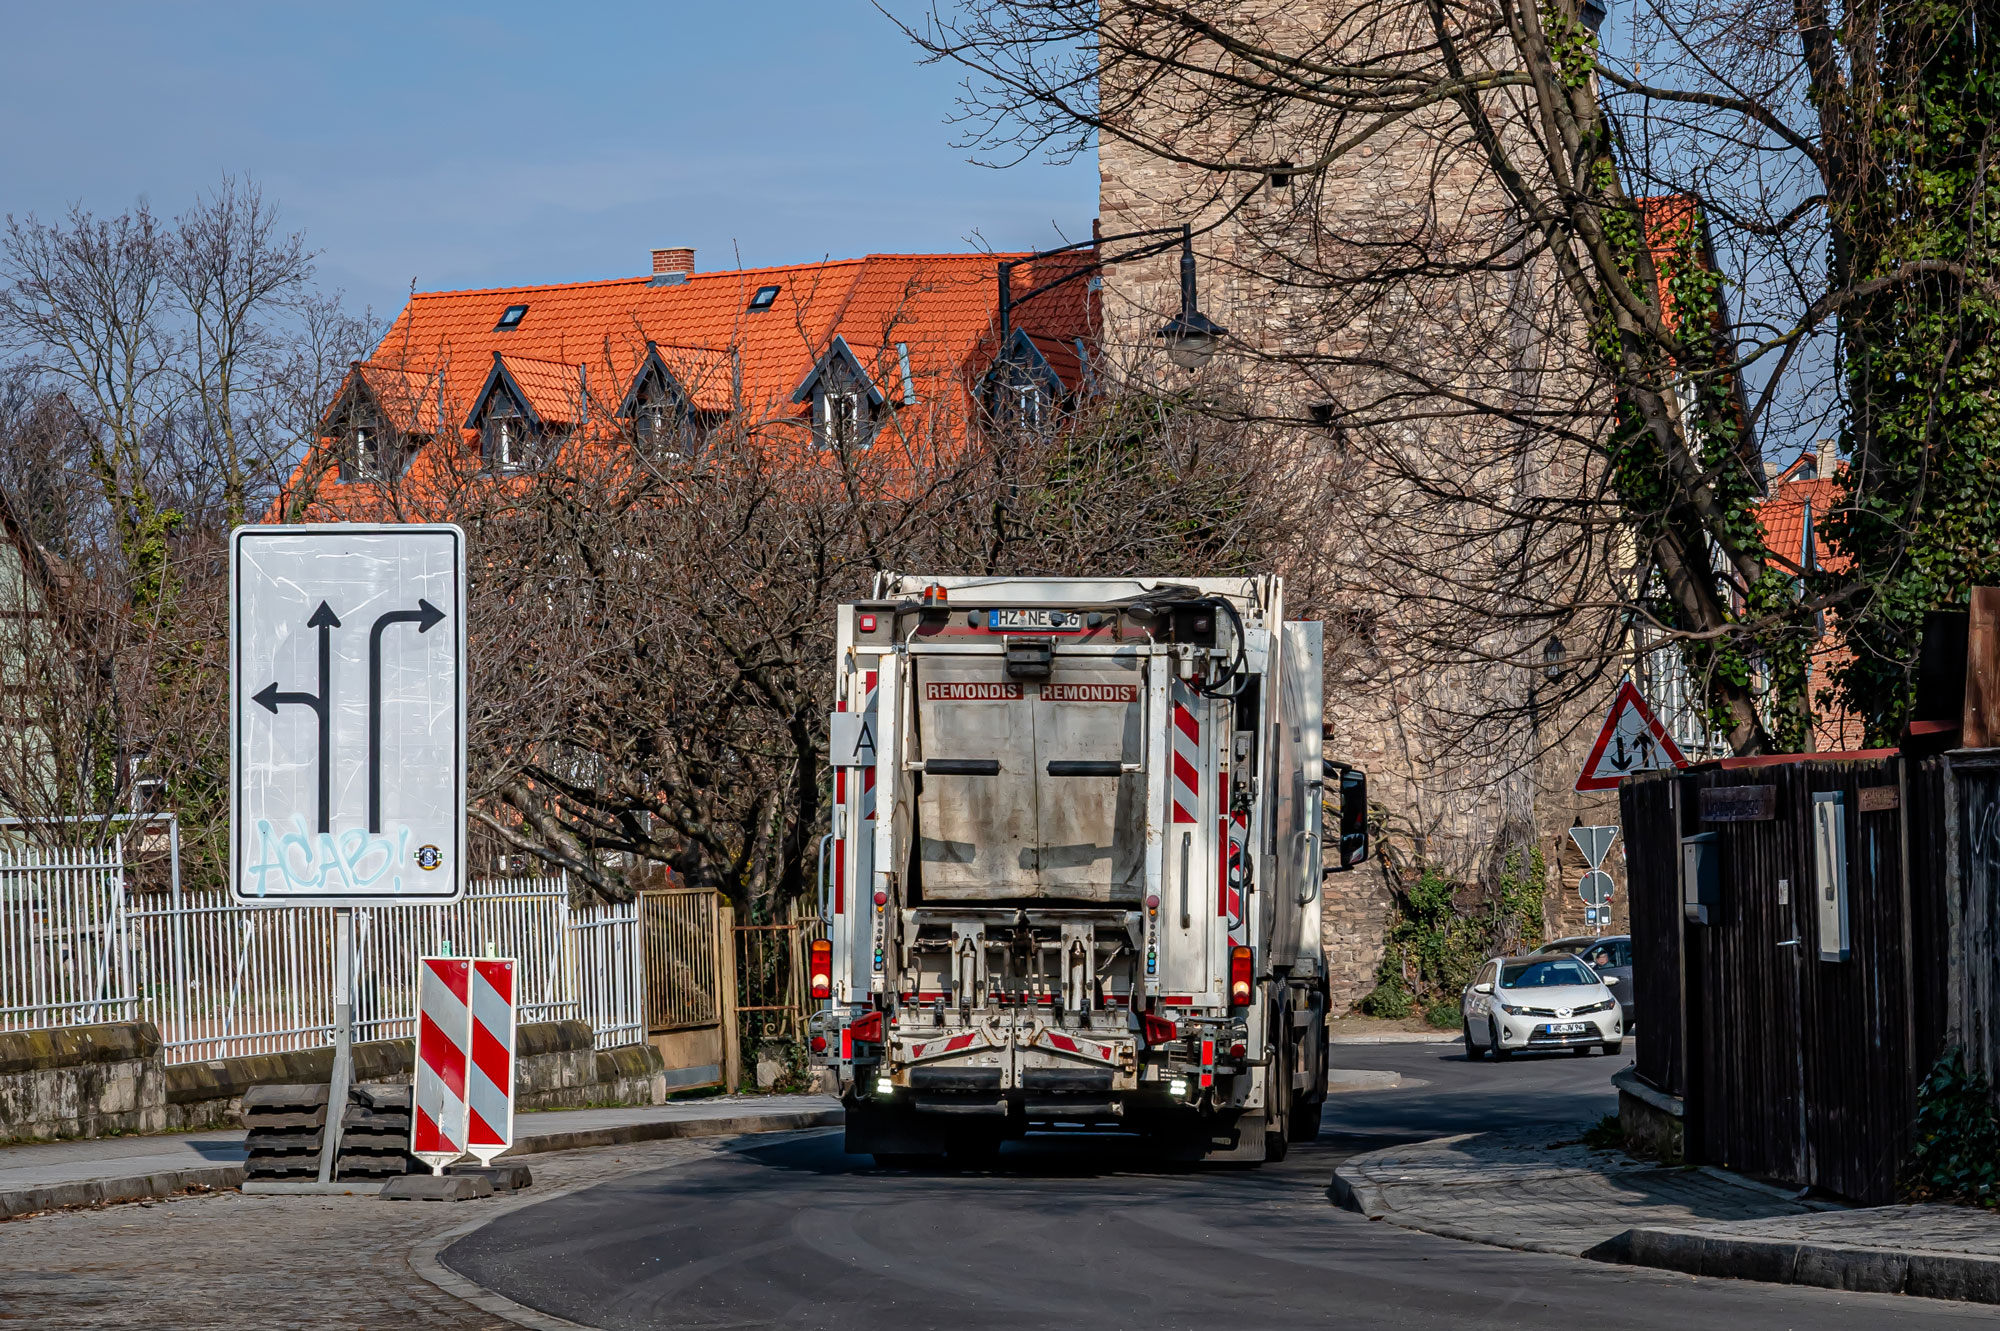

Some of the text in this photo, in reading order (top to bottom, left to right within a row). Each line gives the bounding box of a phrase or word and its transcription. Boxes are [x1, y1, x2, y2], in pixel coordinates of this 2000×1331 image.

[999, 610, 1018, 625] HZ
[1028, 611, 1047, 626] NE
[927, 683, 1017, 699] REMONDIS
[1041, 685, 1131, 701] REMONDIS
[853, 721, 876, 757] A
